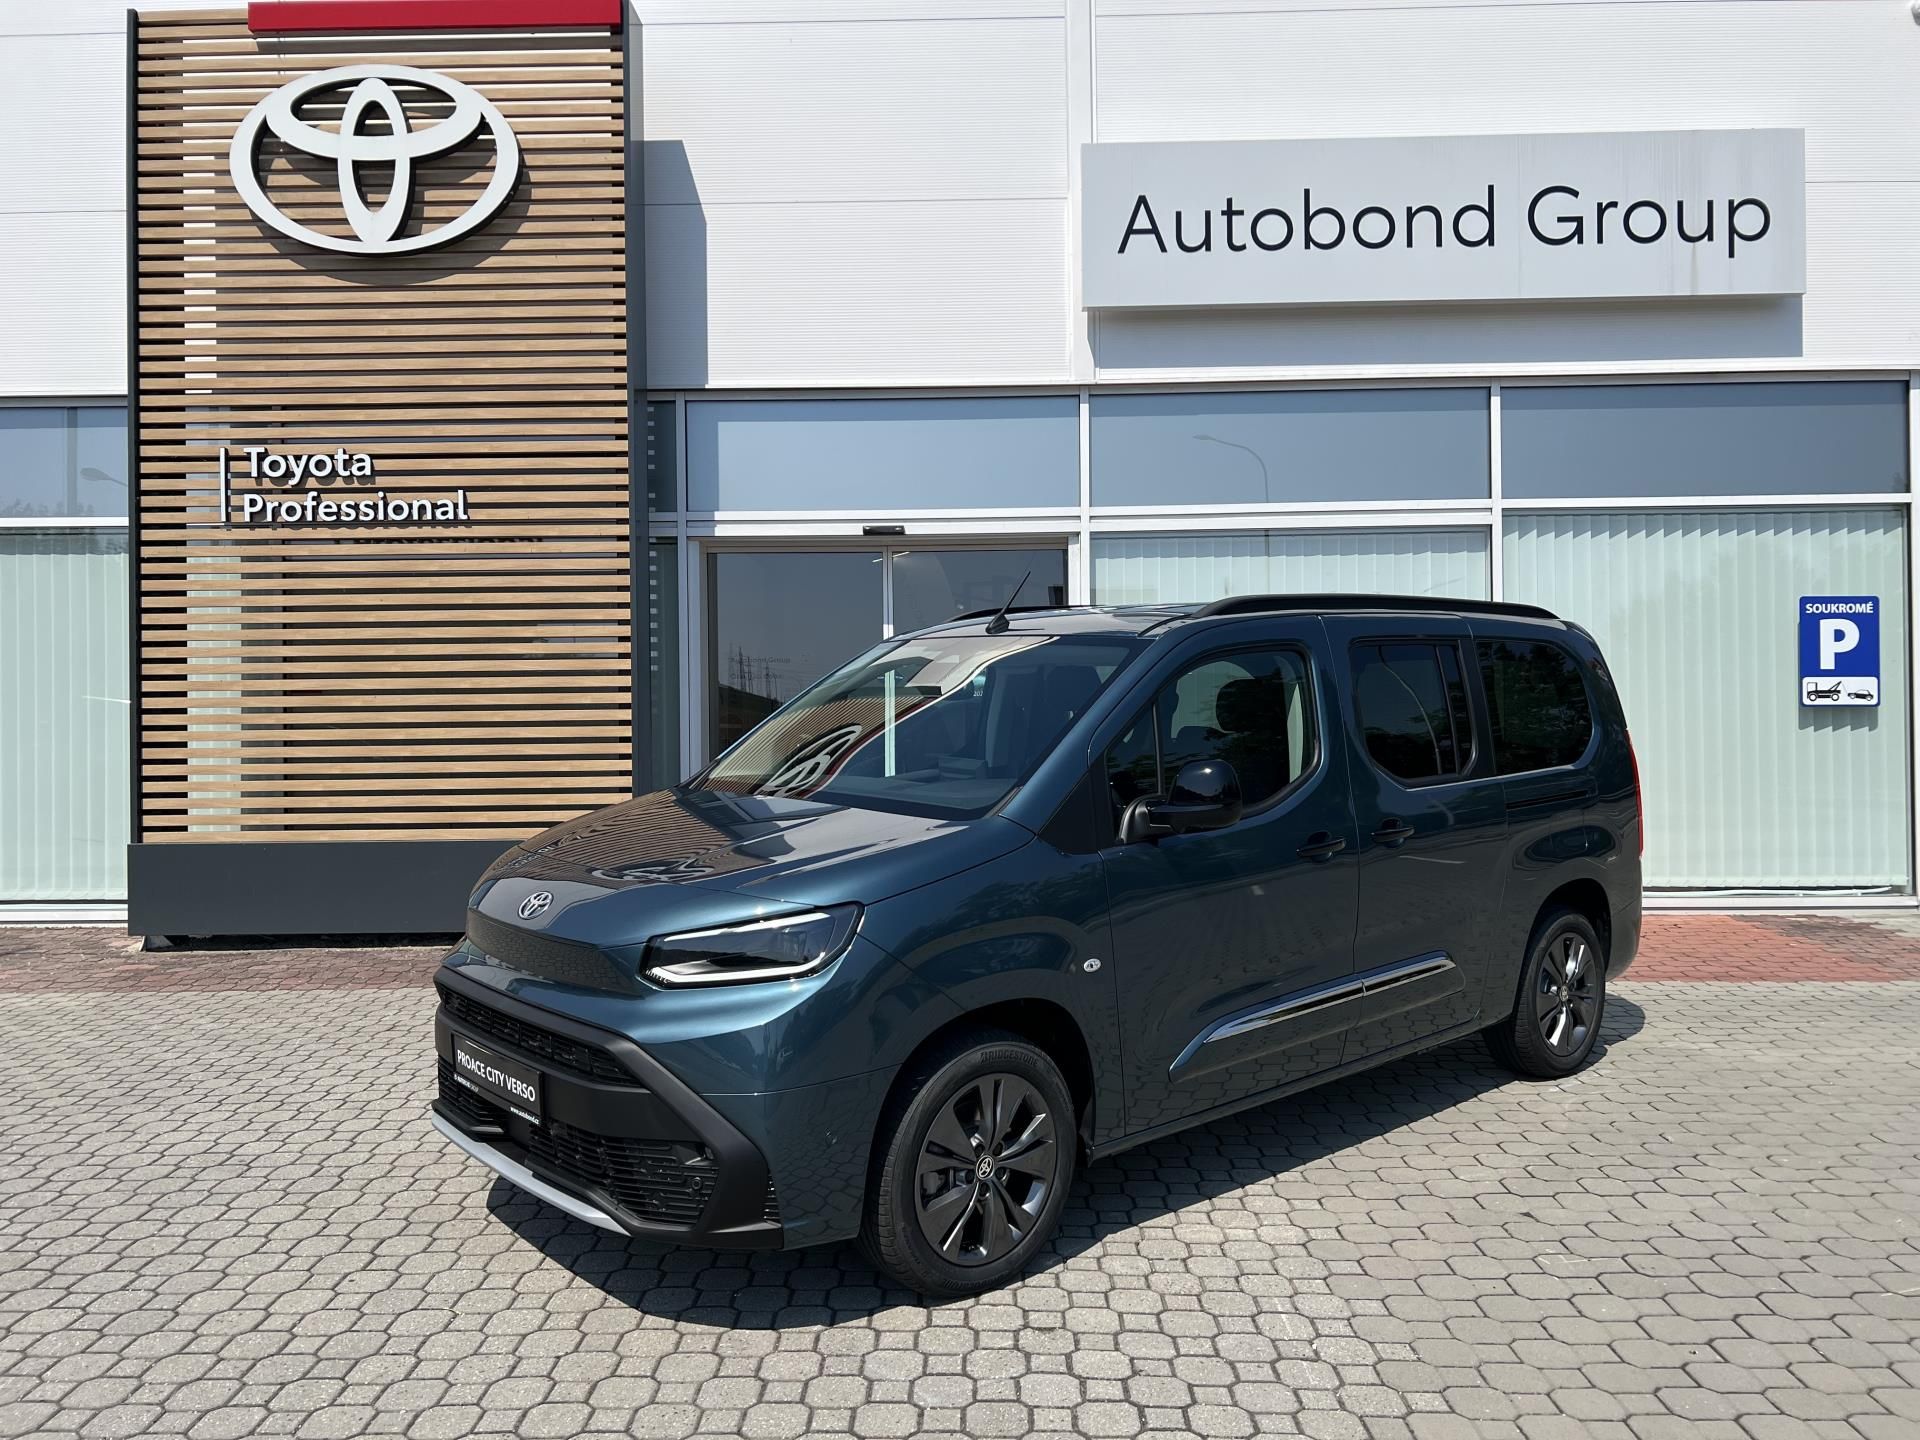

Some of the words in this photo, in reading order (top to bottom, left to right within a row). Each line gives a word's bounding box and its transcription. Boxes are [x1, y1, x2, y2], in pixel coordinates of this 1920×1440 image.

[1117, 184, 1495, 254] Autobond
[1527, 184, 1771, 258] Group
[243, 447, 372, 486] Toyota
[243, 489, 468, 522] Professional
[1805, 601, 1874, 614] SOUKROMÉ
[1819, 618, 1860, 670] P
[457, 1049, 486, 1077] PROACE
[486, 1066, 506, 1087] CITY
[505, 1075, 536, 1102] VERSO
[979, 1048, 1039, 1067] BRIDGESTONE
